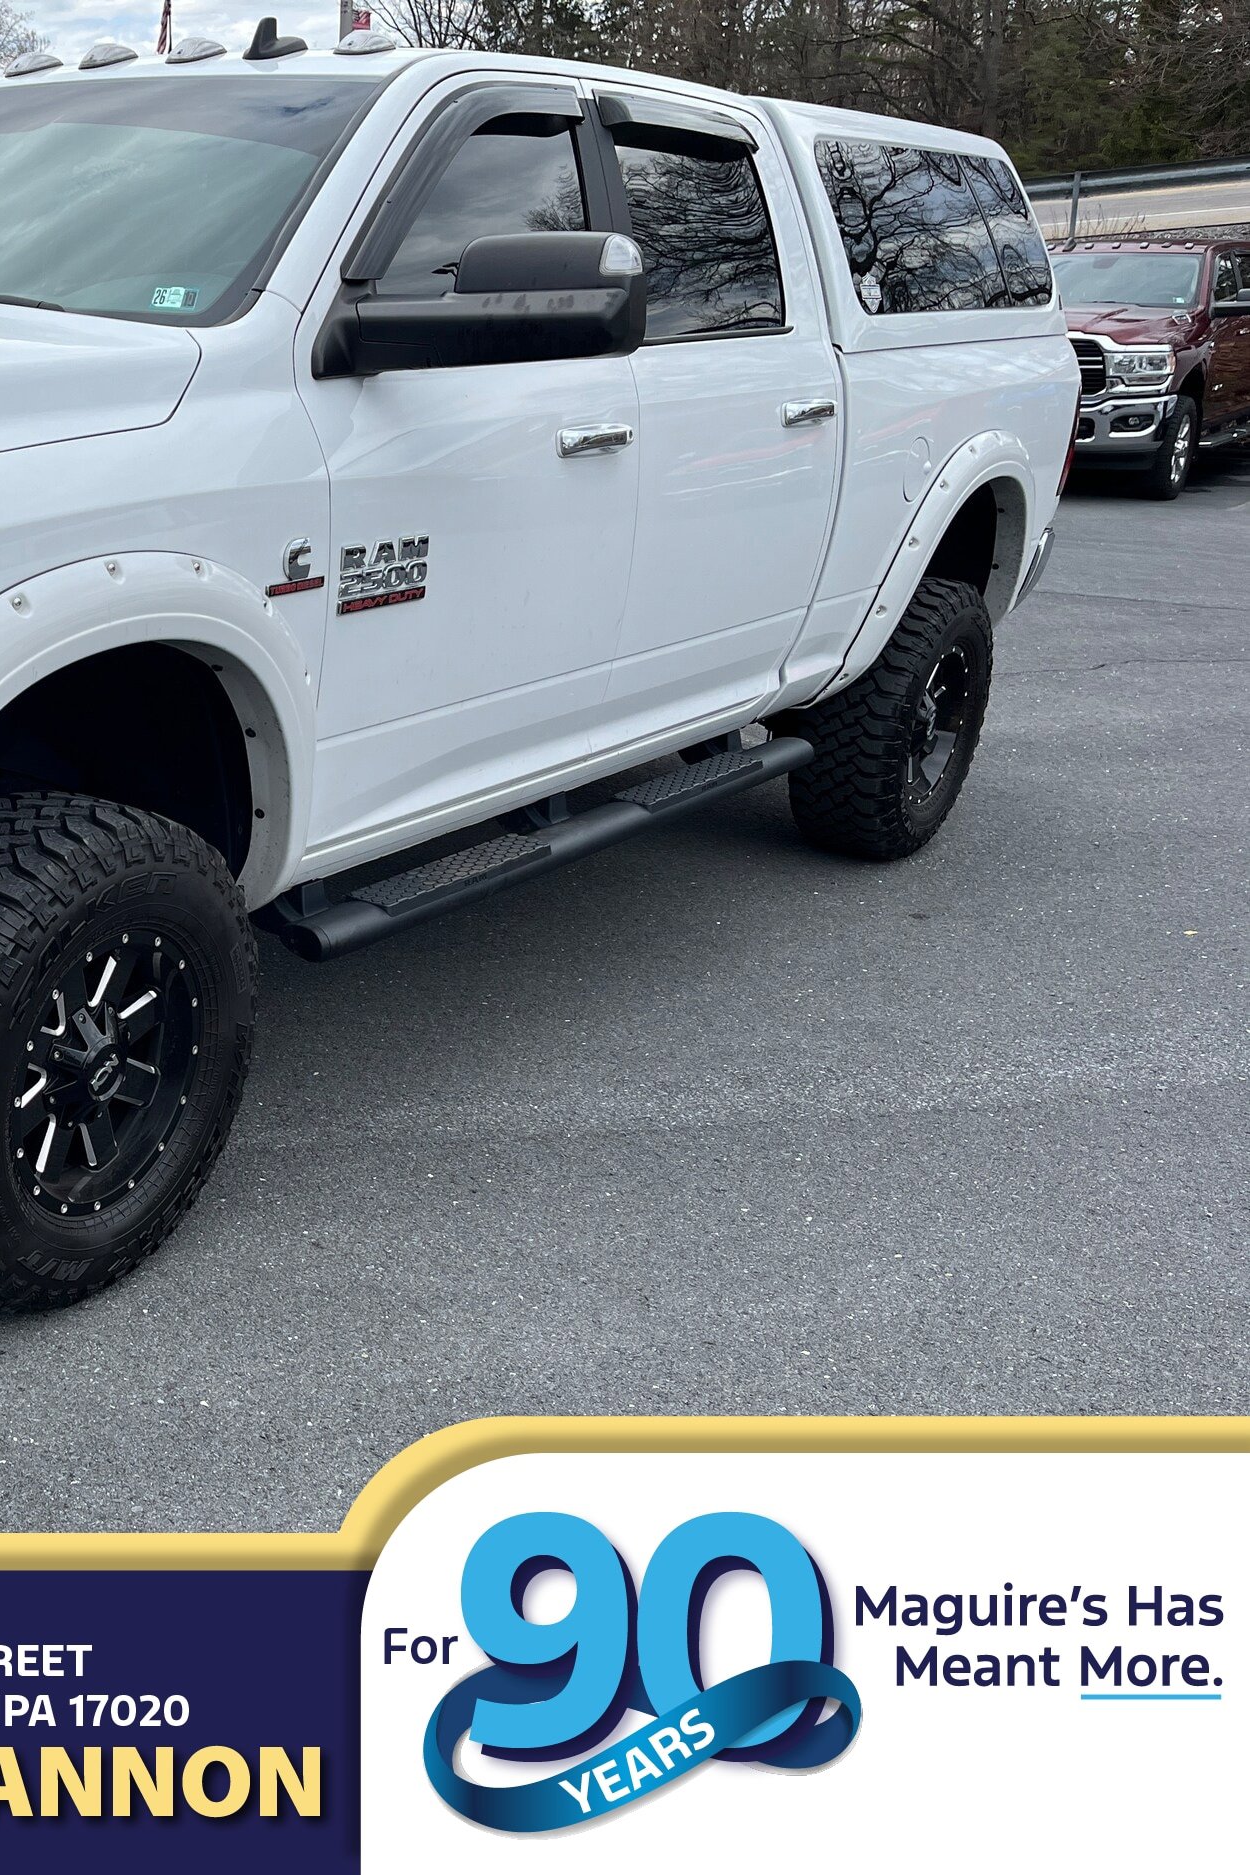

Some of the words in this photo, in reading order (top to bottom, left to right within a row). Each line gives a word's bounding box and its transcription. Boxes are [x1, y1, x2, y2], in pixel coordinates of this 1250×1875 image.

[153, 289, 167, 304] 26
[340, 534, 429, 571] RAM
[338, 559, 428, 599] 2500
[343, 597, 385, 613] HEAVY
[388, 587, 424, 602] DUTY
